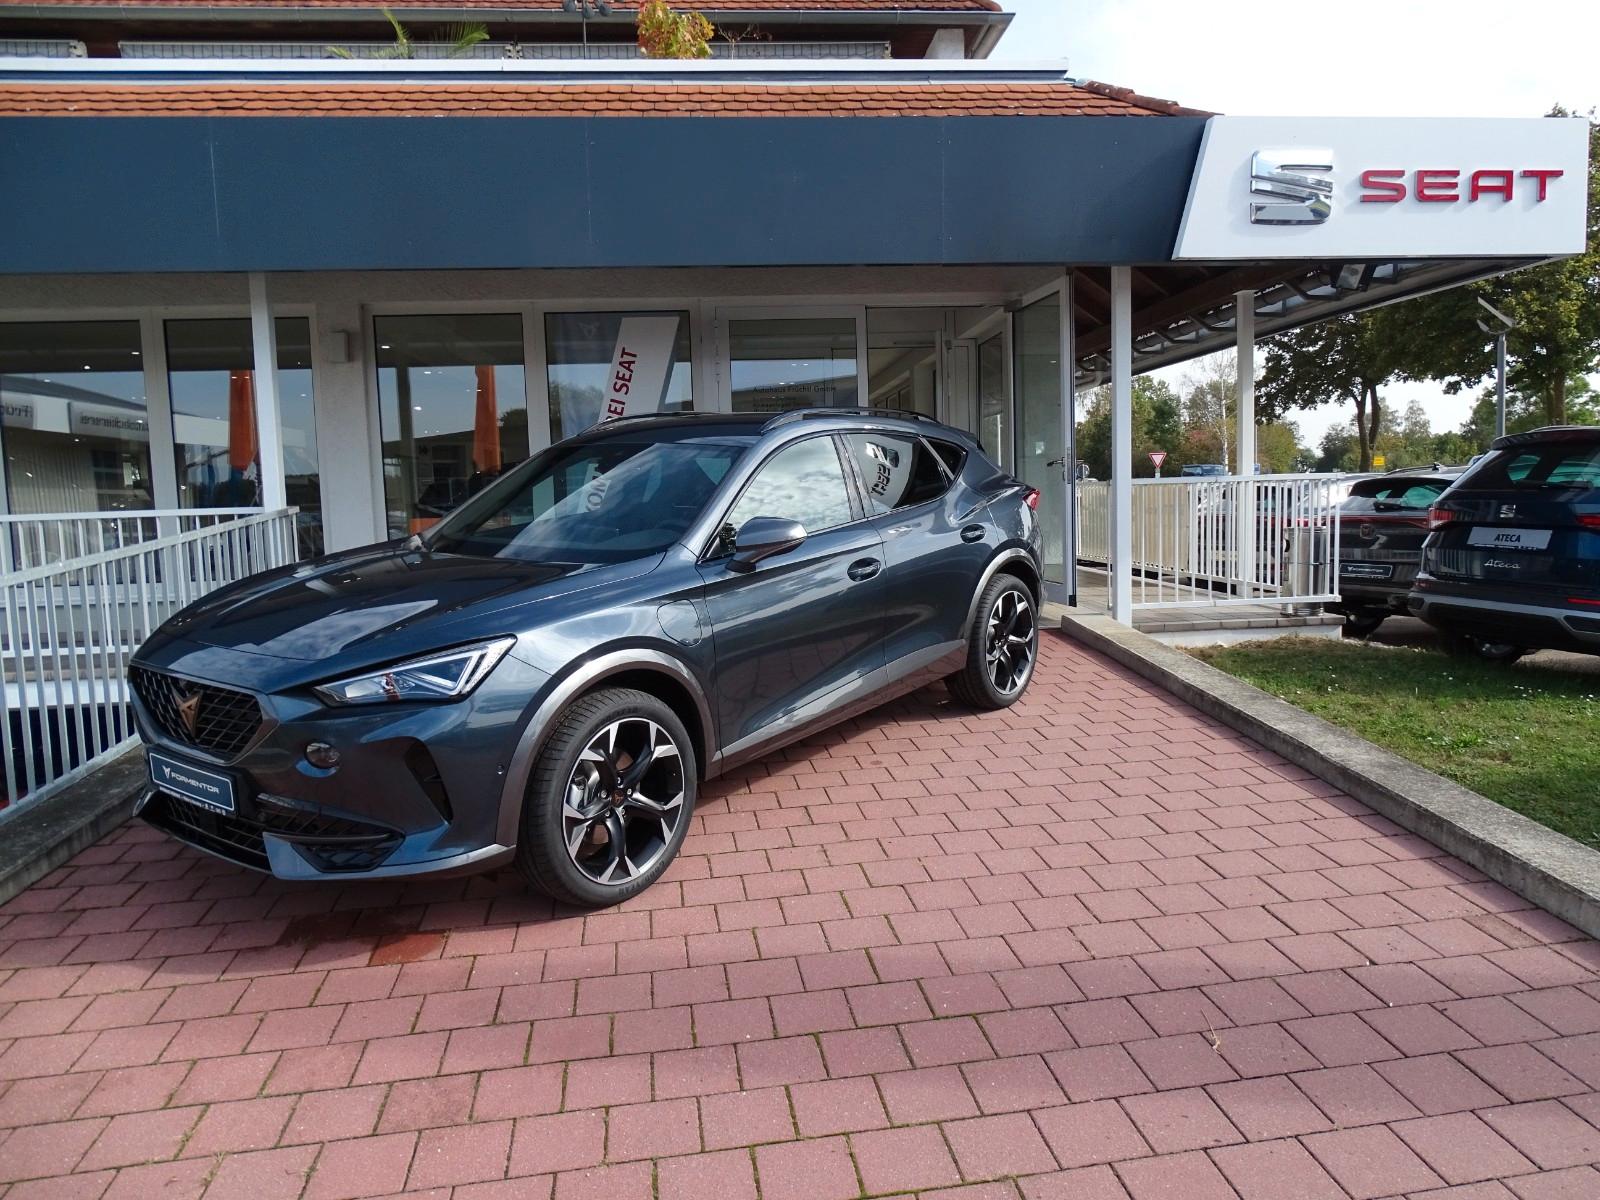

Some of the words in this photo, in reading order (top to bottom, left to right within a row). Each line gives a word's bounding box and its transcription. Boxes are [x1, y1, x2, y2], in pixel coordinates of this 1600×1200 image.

[1360, 169, 1564, 203] SEAT
[613, 347, 638, 396] SEAT
[606, 399, 626, 421] EI
[1494, 533, 1521, 543] ATECA
[1484, 559, 1521, 569] Ateca
[171, 772, 220, 795] FORMENTOR
